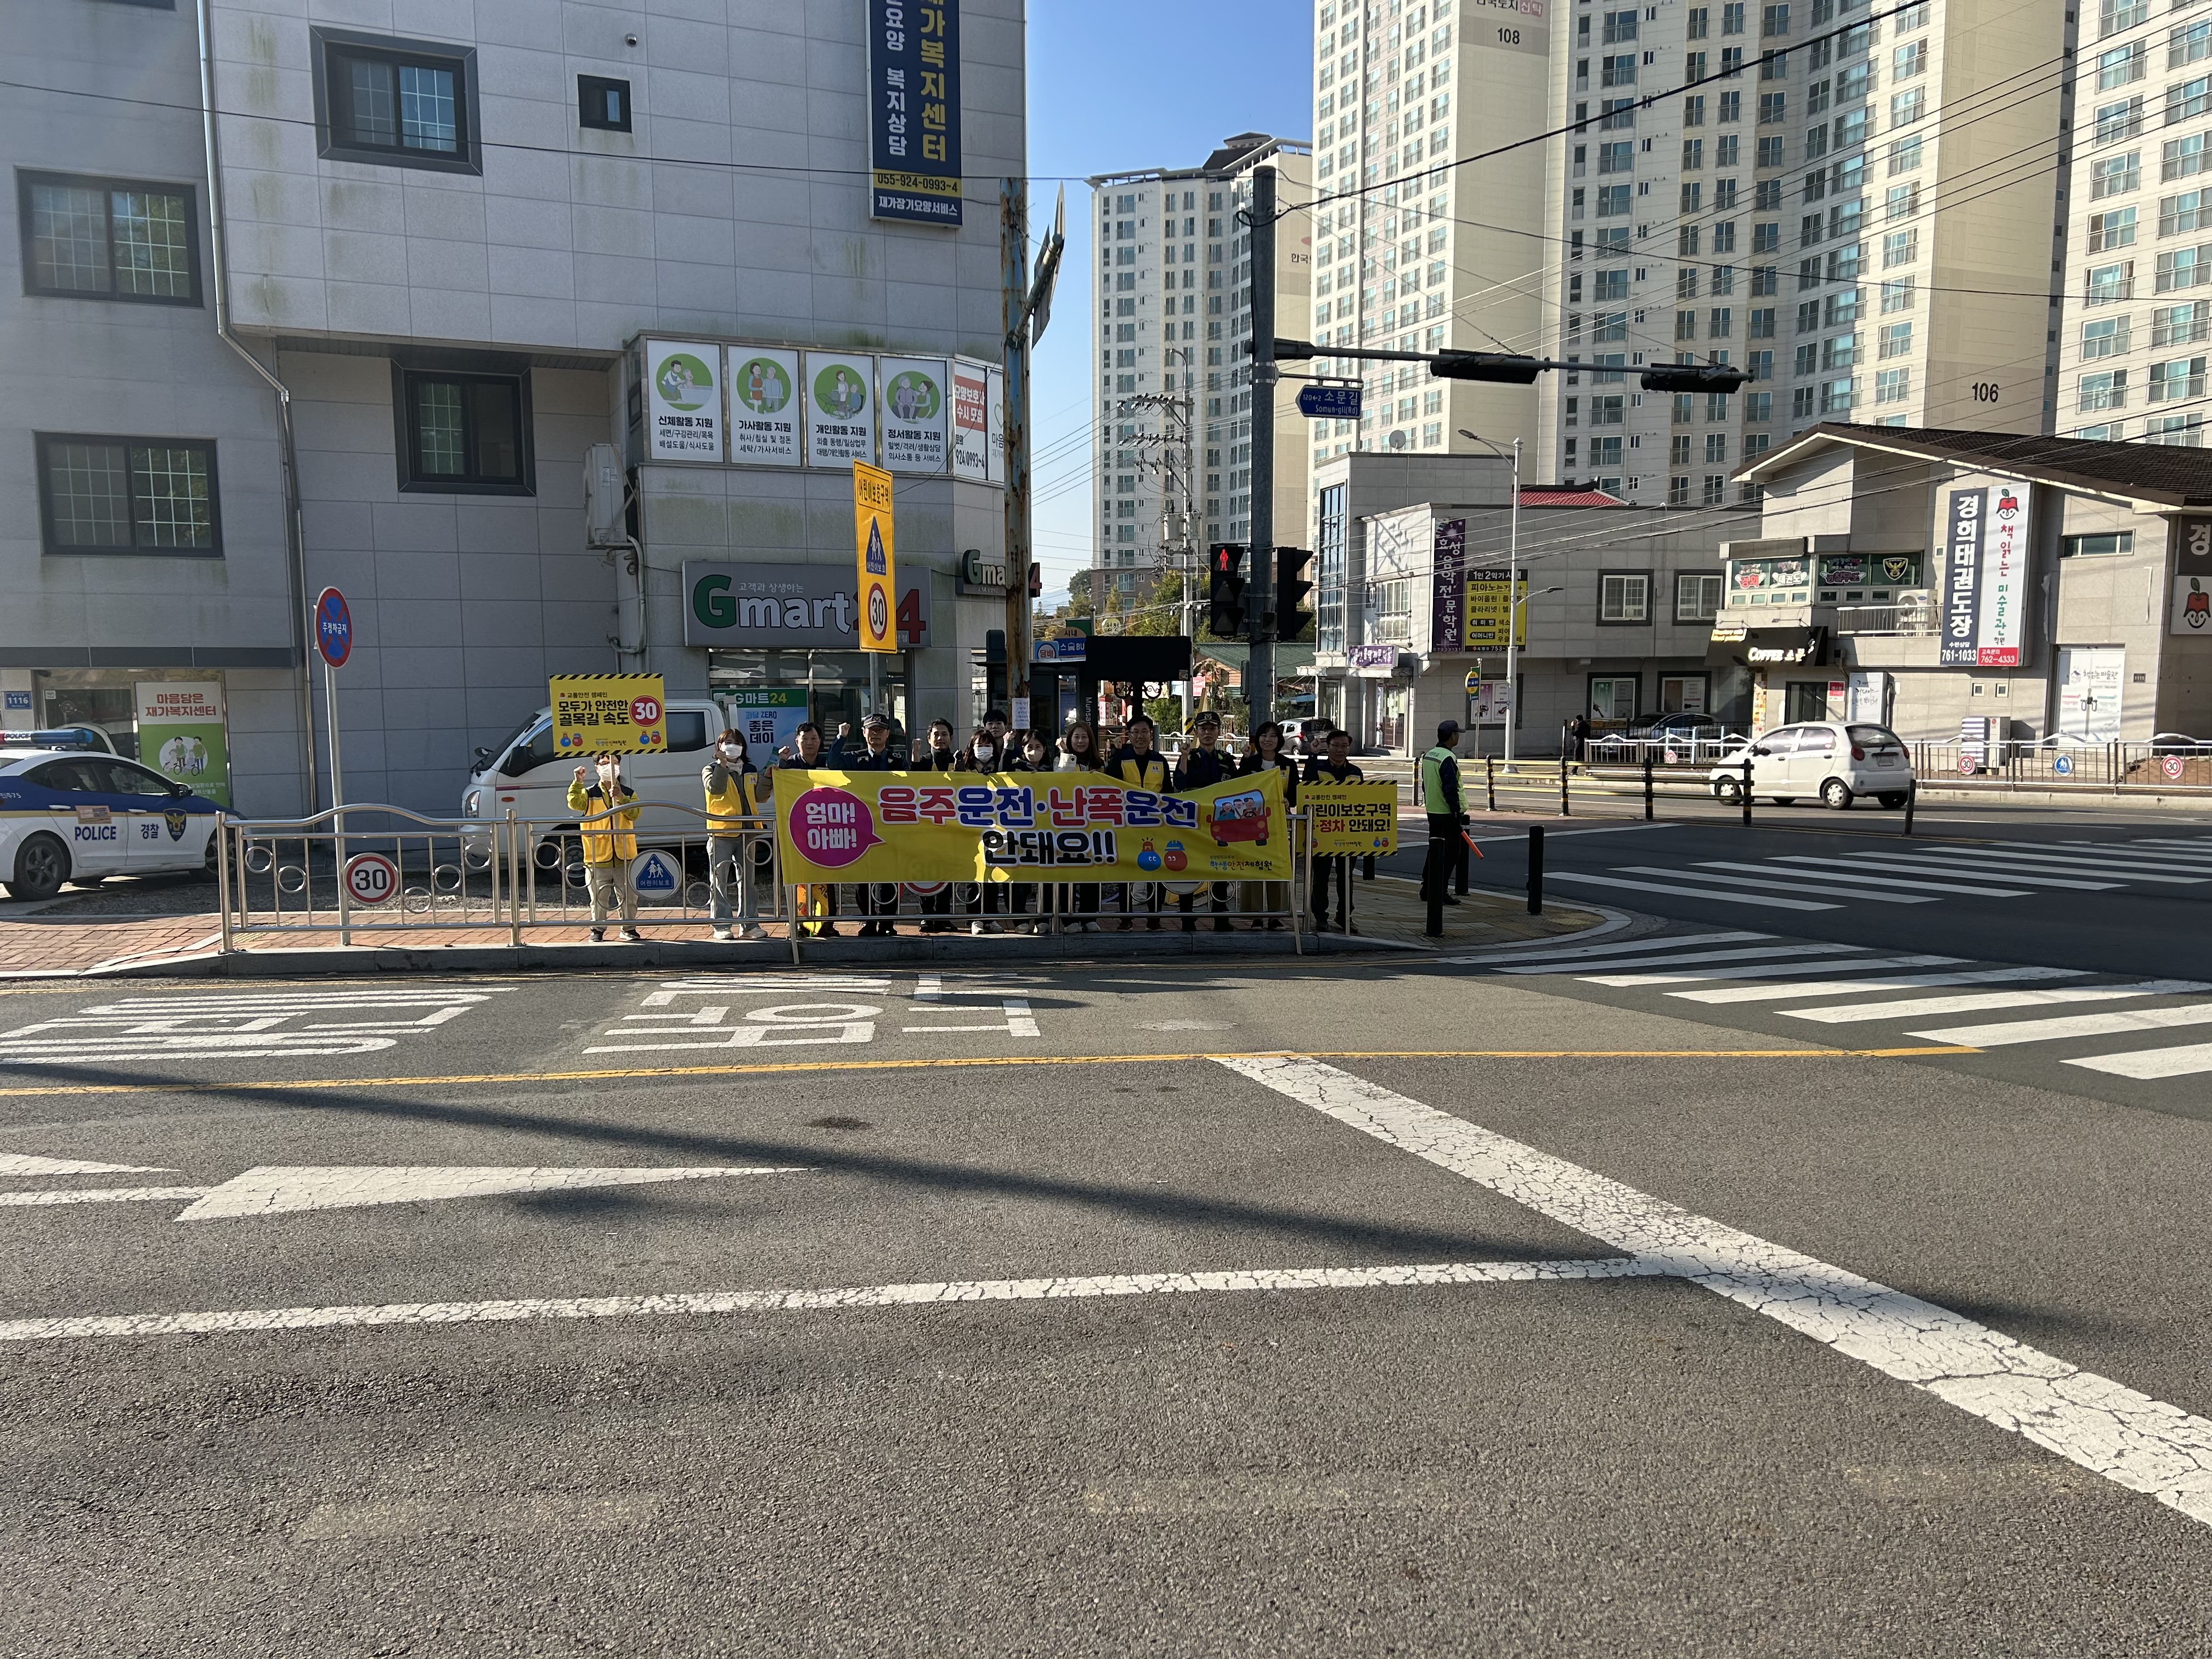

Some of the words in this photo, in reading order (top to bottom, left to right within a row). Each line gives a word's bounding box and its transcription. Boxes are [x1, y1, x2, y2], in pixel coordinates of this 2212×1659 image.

[1497, 27, 1520, 45] 108
[921, 0, 946, 161] 가복지센터
[887, 67, 907, 156] 복지상담
[877, 172, 958, 193] 055-924-0993~4
[878, 195, 958, 216] 재가장기요양서비스
[955, 385, 985, 405] 요양보호사
[1324, 390, 1358, 406] 소문길
[1972, 382, 1999, 403] 106
[957, 404, 969, 420] 수시
[970, 408, 983, 424] 모집
[1315, 404, 1358, 416] Somun-gil(Rd)
[658, 415, 693, 427] 신체활동
[696, 417, 713, 428] 지원
[738, 420, 772, 431] 가사활동
[774, 422, 791, 432] 지원
[659, 428, 714, 439] 세면/구강관리/목욕
[816, 424, 848, 435] 개인활동
[850, 426, 867, 436] 지원
[888, 429, 922, 439] 정서활동
[924, 431, 941, 441] 지원
[739, 433, 768, 443] 취사/침실
[770, 435, 776, 443] 및
[779, 436, 791, 444] 정돈
[816, 437, 828, 446] 외출
[830, 438, 866, 448] 동행/일상업무
[659, 440, 714, 451] 배설도움/식사도움
[740, 444, 792, 455] 세탁/가사서비스
[889, 452, 913, 461] 의사소통
[923, 454, 941, 462] 서비스
[956, 449, 985, 470] 924)0993~4
[858, 477, 889, 508] 어린이보호구역
[2188, 524, 2211, 556] 경
[866, 561, 886, 573] 어린이보호
[1950, 495, 1979, 638] 경희태권도장
[1485, 571, 1505, 579] 2악기
[738, 582, 766, 593] 고객과
[768, 583, 804, 594] 상생하는
[872, 597, 884, 627] 30
[323, 622, 347, 634] 주정차금지
[1994, 637, 2005, 646] 학원
[1040, 650, 1054, 658] 담배
[1942, 649, 1976, 662] 761-1033
[1980, 655, 2015, 663] 762-4333
[156, 693, 204, 704] 마음담은
[145, 706, 216, 716] 재가복지센터
[558, 701, 592, 712] 모두가
[595, 699, 629, 712] 안전한
[559, 713, 600, 726] 골목길
[603, 712, 630, 725] 속도
[635, 702, 657, 720] 30
[760, 711, 777, 719] ZERO
[749, 720, 774, 732] 좋은
[749, 732, 774, 744] 데이
[1962, 760, 1971, 769] 30
[2167, 762, 2177, 771] 30
[805, 802, 856, 825] 엄마!
[141, 823, 159, 839] 경찰
[1348, 819, 1391, 832] 안돼요!
[75, 826, 116, 840] POLICE
[807, 827, 857, 850] 아빠!
[981, 829, 1119, 867] 안돼요!!
[1210, 860, 1272, 871] 학생안전체험원
[355, 869, 387, 891] 30
